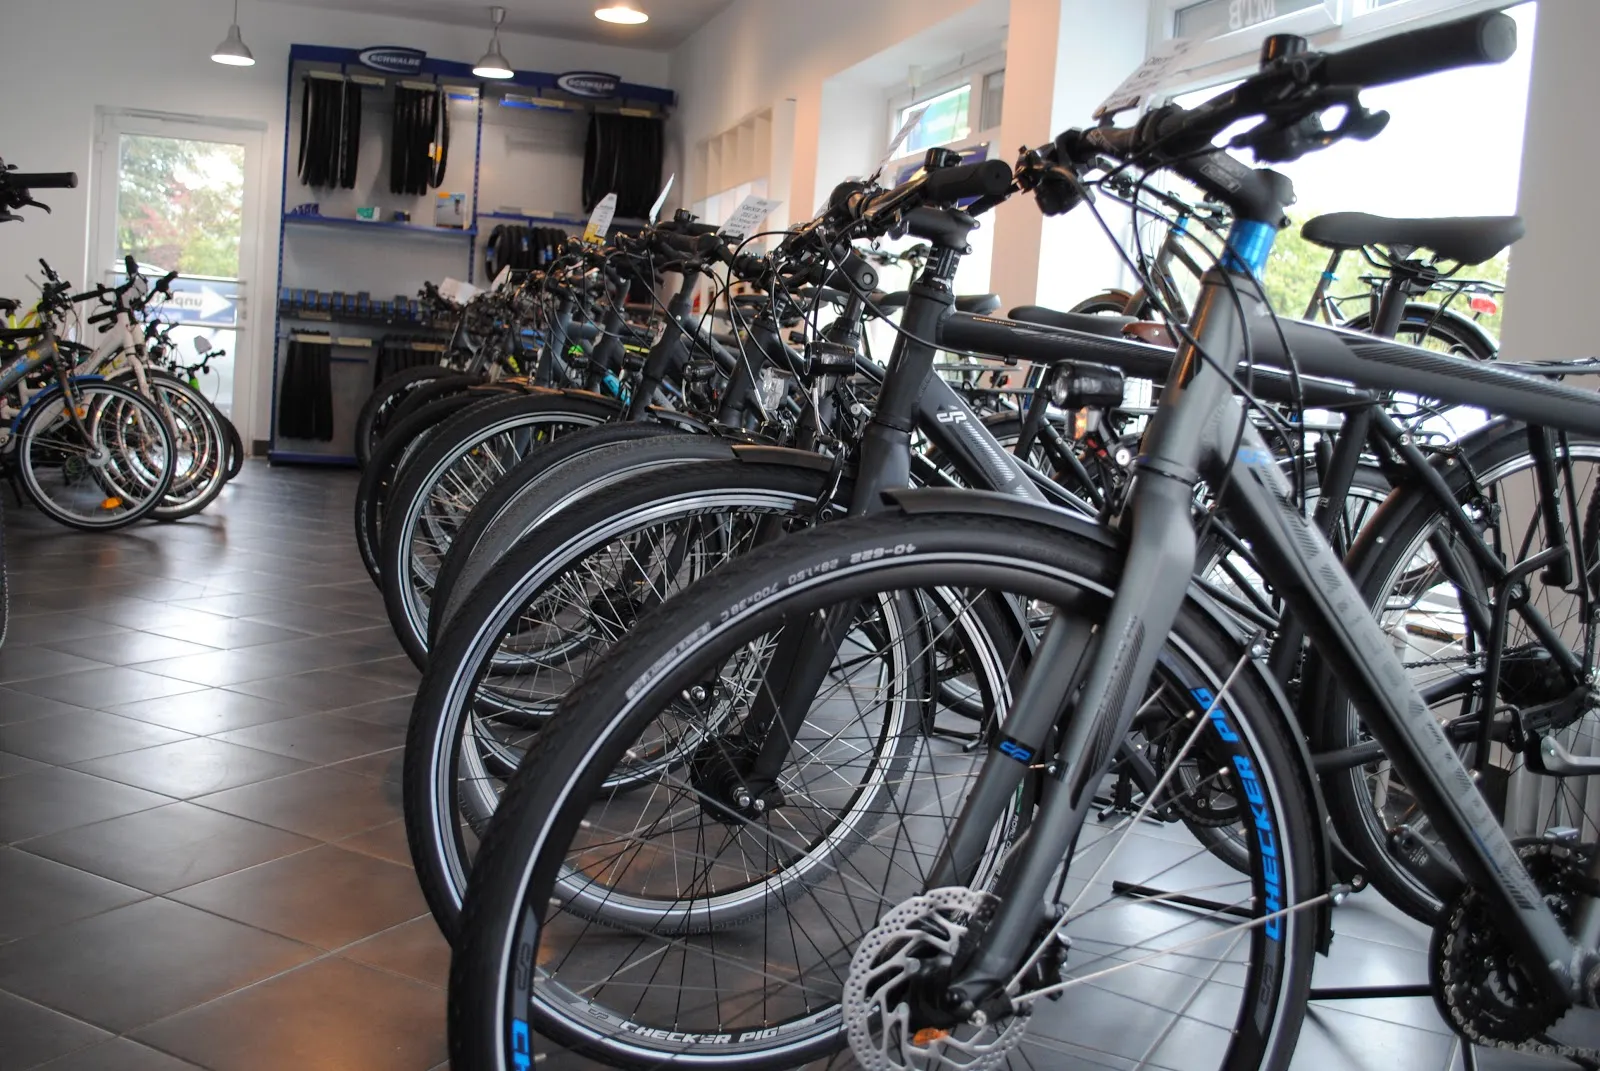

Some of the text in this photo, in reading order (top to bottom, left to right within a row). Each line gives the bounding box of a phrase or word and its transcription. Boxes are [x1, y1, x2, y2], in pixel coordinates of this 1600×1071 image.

[370, 54, 421, 67] SCHWALBE
[567, 78, 615, 91] SCHWALBE
[849, 543, 917, 565] 40-622
[786, 557, 841, 586] 28x1.50
[1189, 686, 1281, 942] CHECKER PIG
[619, 1020, 732, 1045] CHECKER
[738, 1025, 780, 1044] PIG
